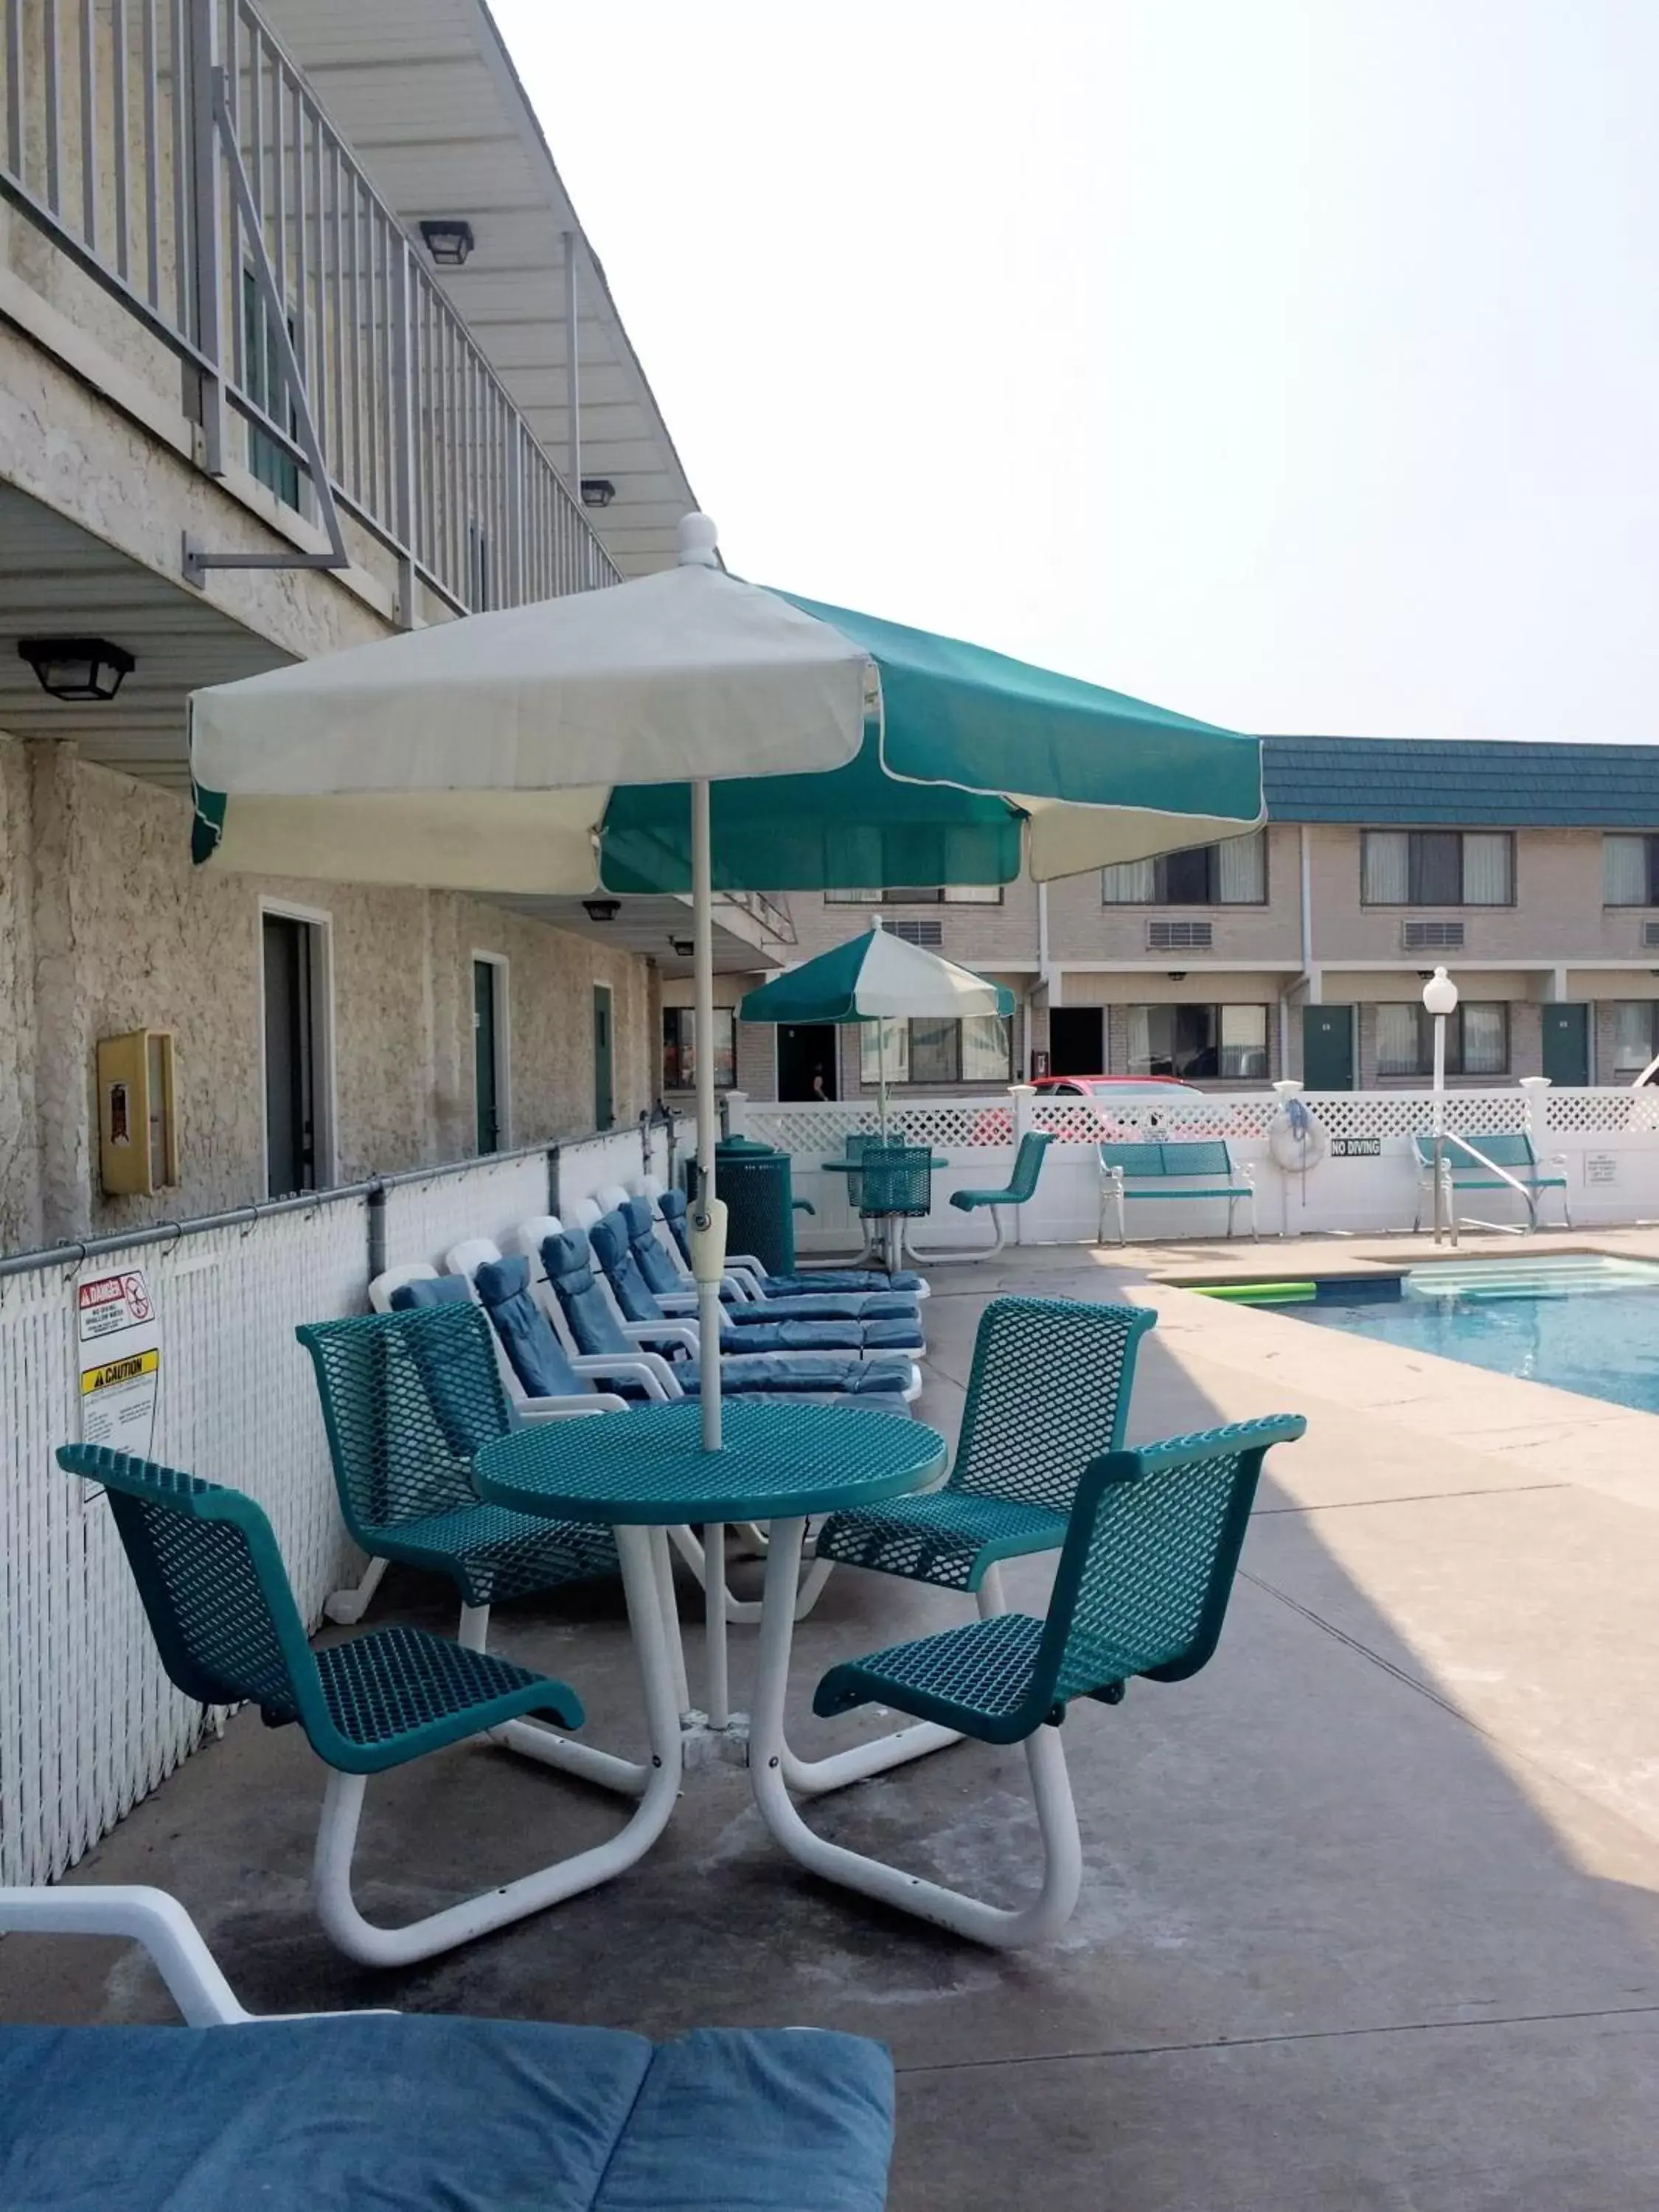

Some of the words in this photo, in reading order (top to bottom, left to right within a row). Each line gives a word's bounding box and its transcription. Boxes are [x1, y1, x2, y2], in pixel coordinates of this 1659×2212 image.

[1332, 1140, 1346, 1155] NO
[1348, 1140, 1380, 1154] DIVING
[89, 1279, 121, 1303] DANGER
[105, 1357, 142, 1383] CAUTION
